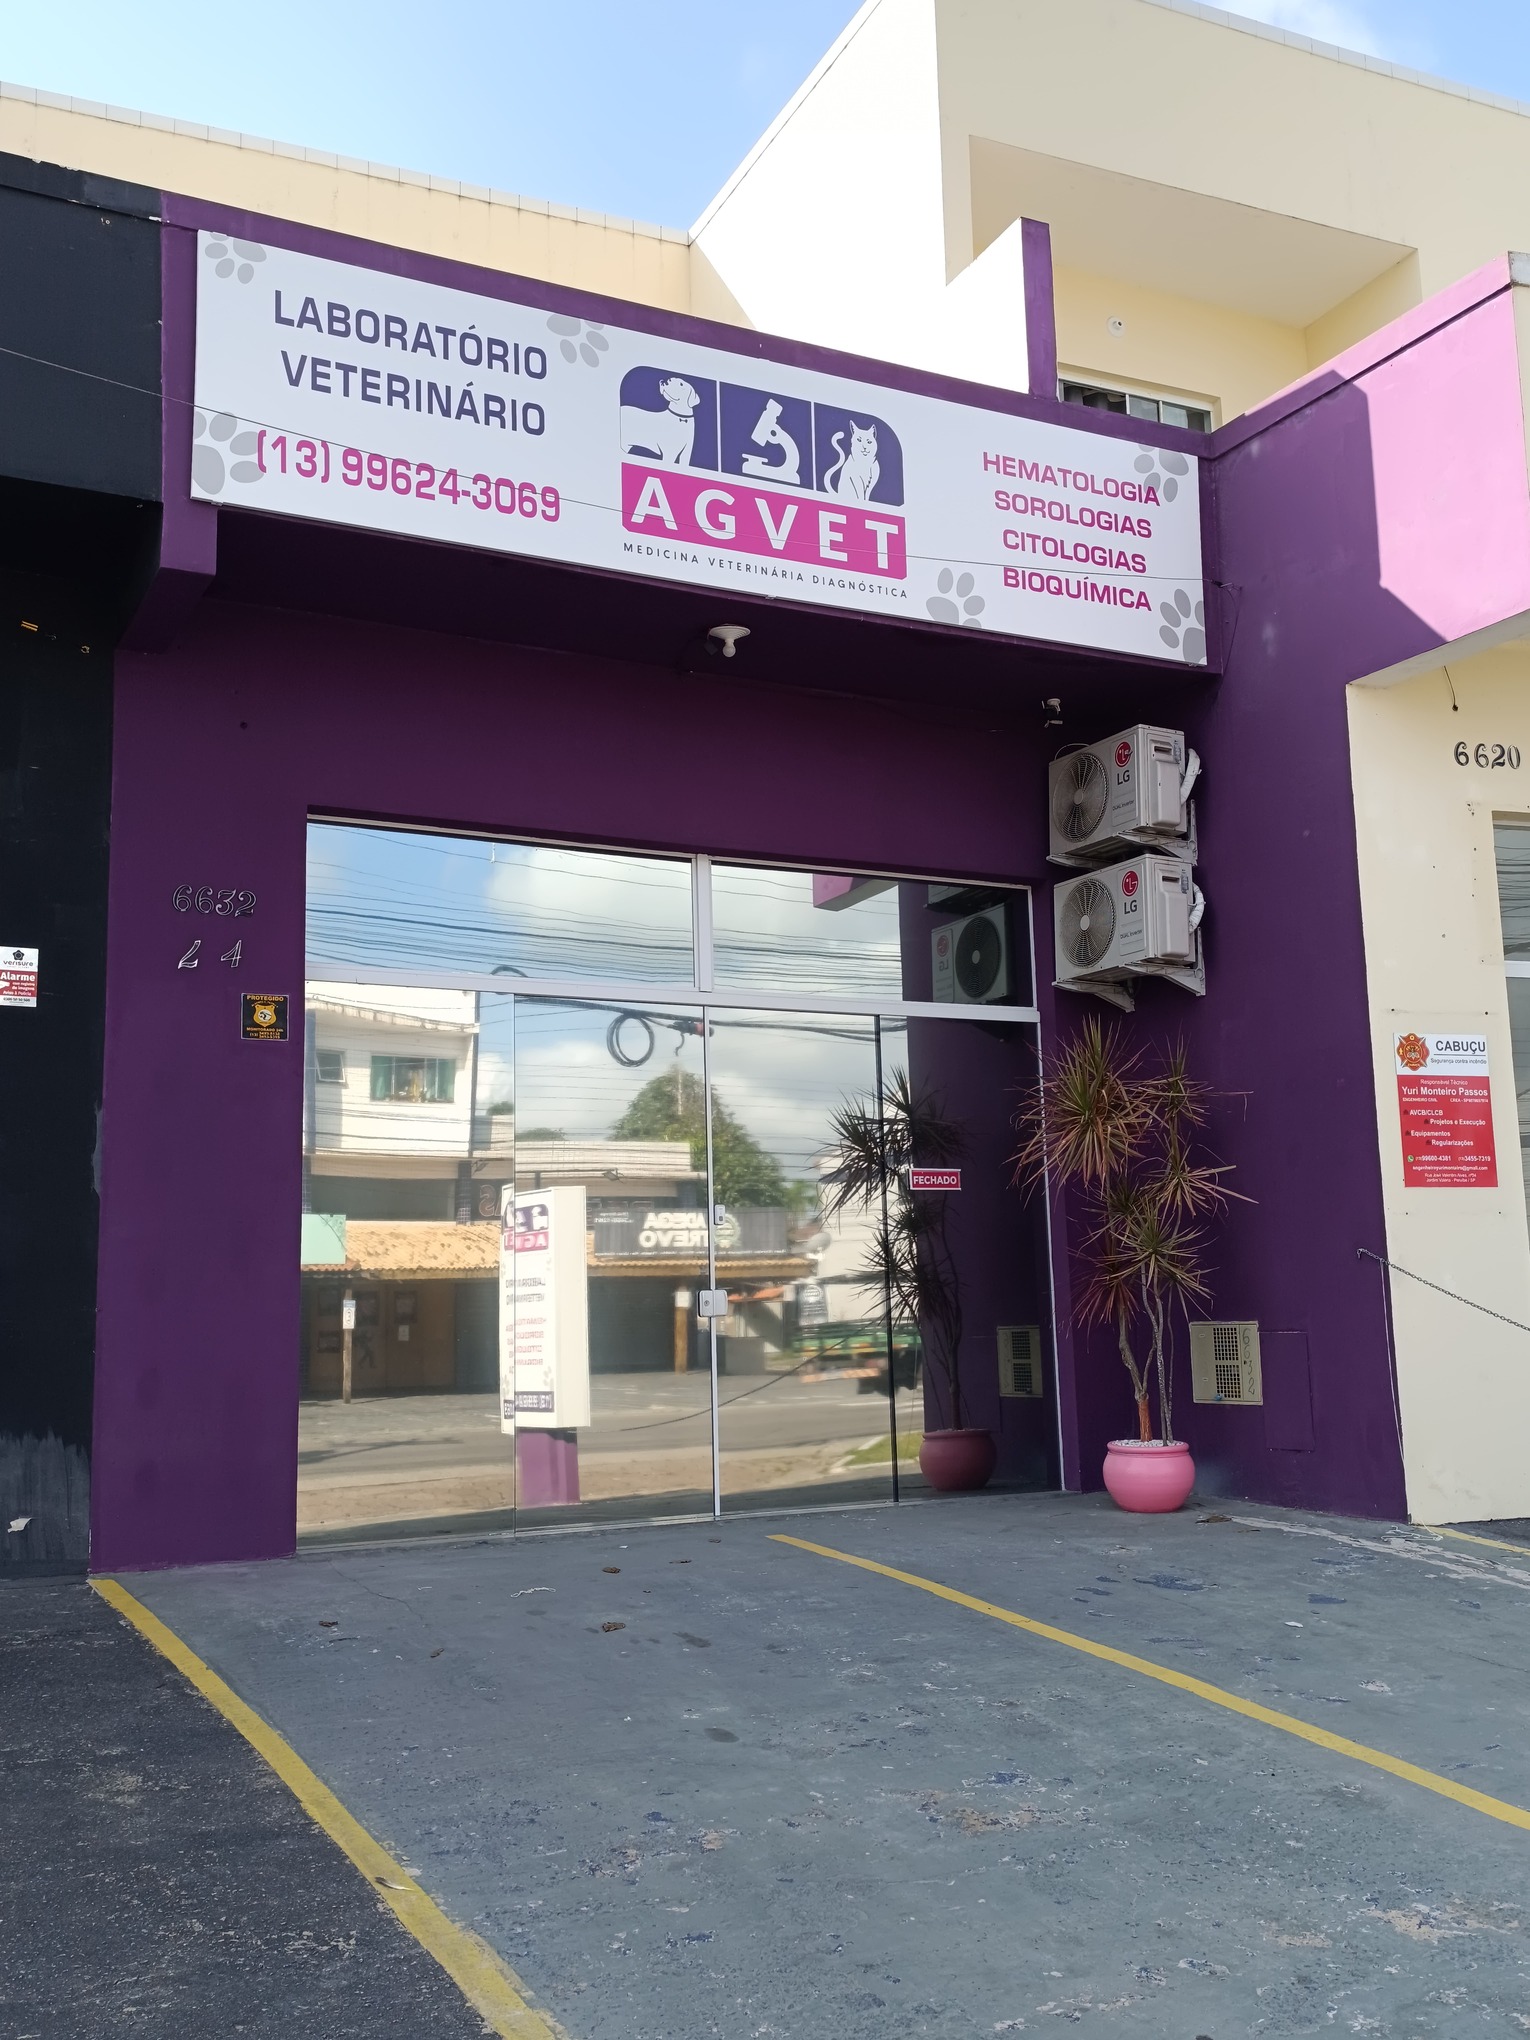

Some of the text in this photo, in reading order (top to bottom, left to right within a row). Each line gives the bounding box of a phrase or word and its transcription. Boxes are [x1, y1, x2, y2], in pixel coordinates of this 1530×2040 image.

[275, 290, 547, 380] LABORATÓRIO
[281, 349, 545, 436] VETERINÁRIO
[257, 430, 561, 523] (13) 99624-3069
[983, 451, 1161, 507] HEMATOLOGIA
[631, 476, 899, 570] AGVET
[994, 490, 1152, 539] SOROLOGIAS
[623, 542, 908, 599] MEDICINA VETERINÁRIA DIAGNÓSTICA
[1002, 529, 1147, 574] CITOLOGIAS
[1003, 567, 1152, 612] BIOQUÍMICA
[1117, 770, 1130, 786] LG
[1453, 741, 1521, 770] 6620
[172, 884, 257, 917] 6632
[1124, 900, 1137, 915] LG
[220, 939, 242, 968] 4
[0, 971, 36, 982] Alarme
[1435, 1040, 1486, 1054] CABUÇU
[1402, 1086, 1488, 1097] Yuri Monteiro Passos
[913, 1175, 957, 1185] FECHADO
[1242, 1328, 1256, 1396] 6632
